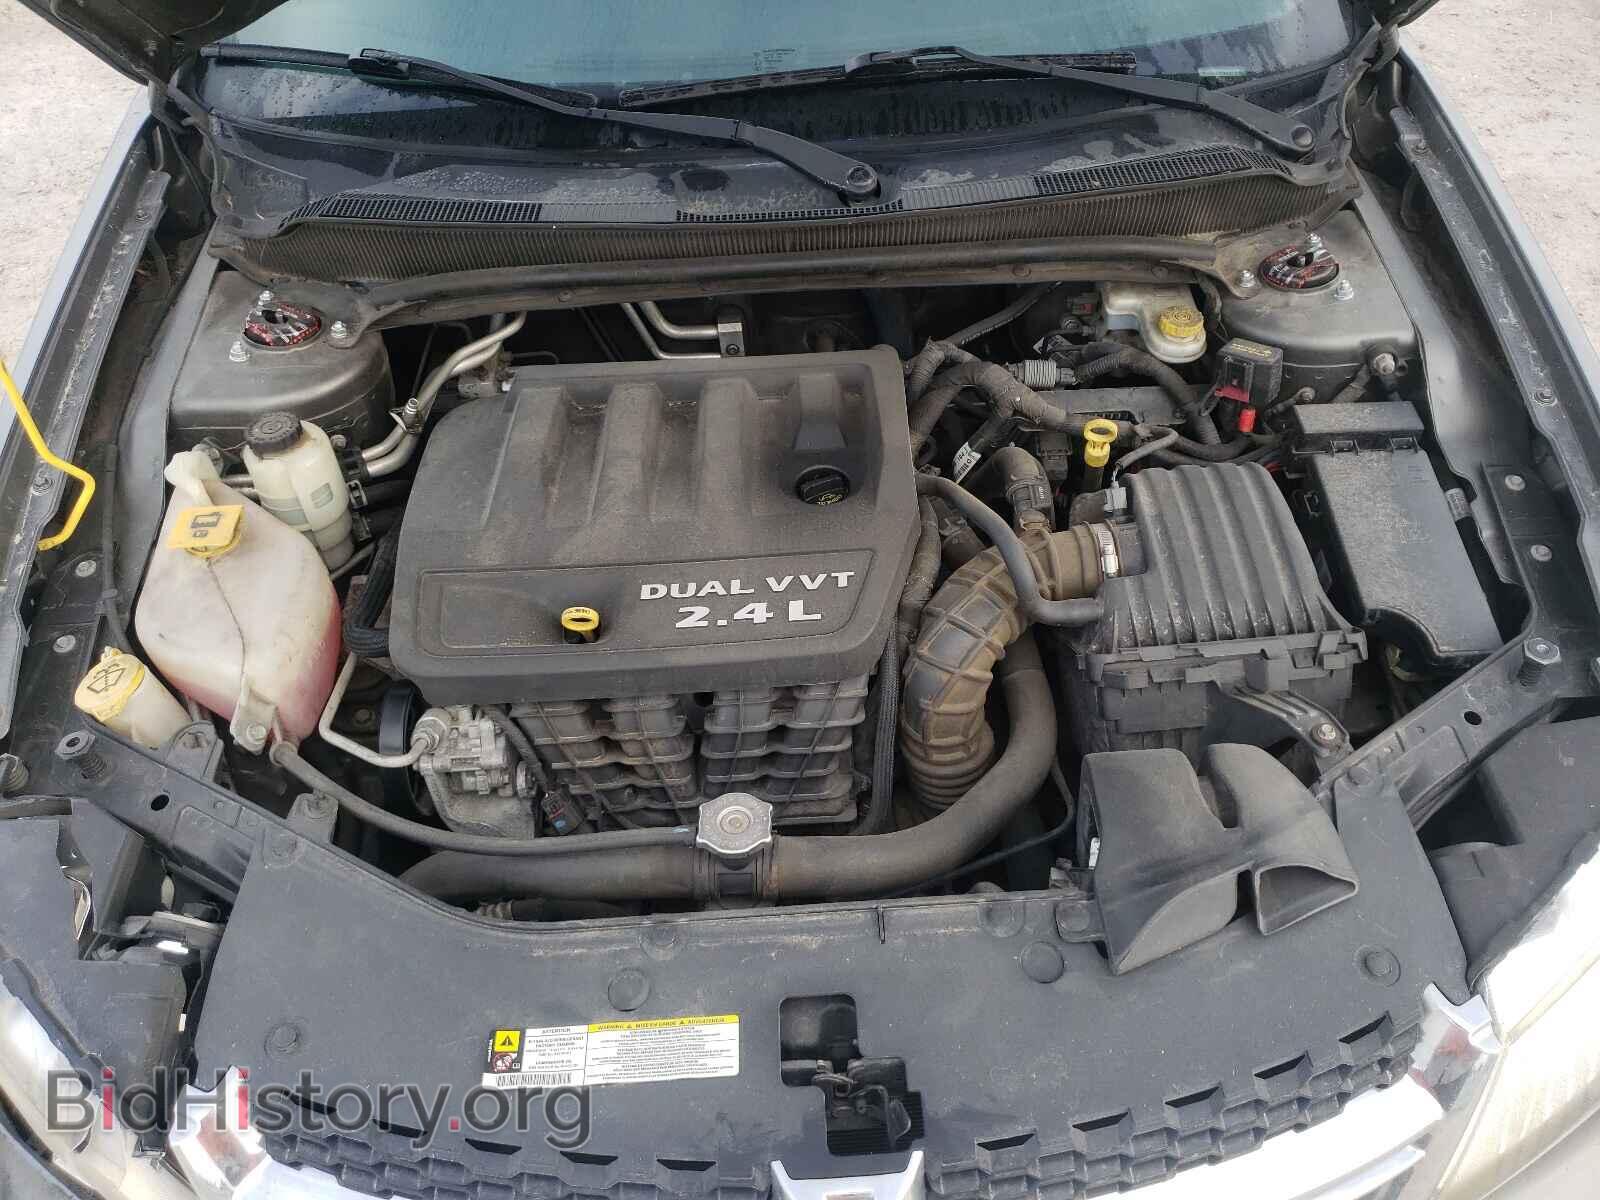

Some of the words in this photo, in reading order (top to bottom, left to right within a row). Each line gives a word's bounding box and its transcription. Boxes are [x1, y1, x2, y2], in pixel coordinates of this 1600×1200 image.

[639, 579, 755, 600] DUAL
[765, 571, 855, 592] VVT
[675, 602, 774, 629] 2.4
[788, 600, 822, 622] L
